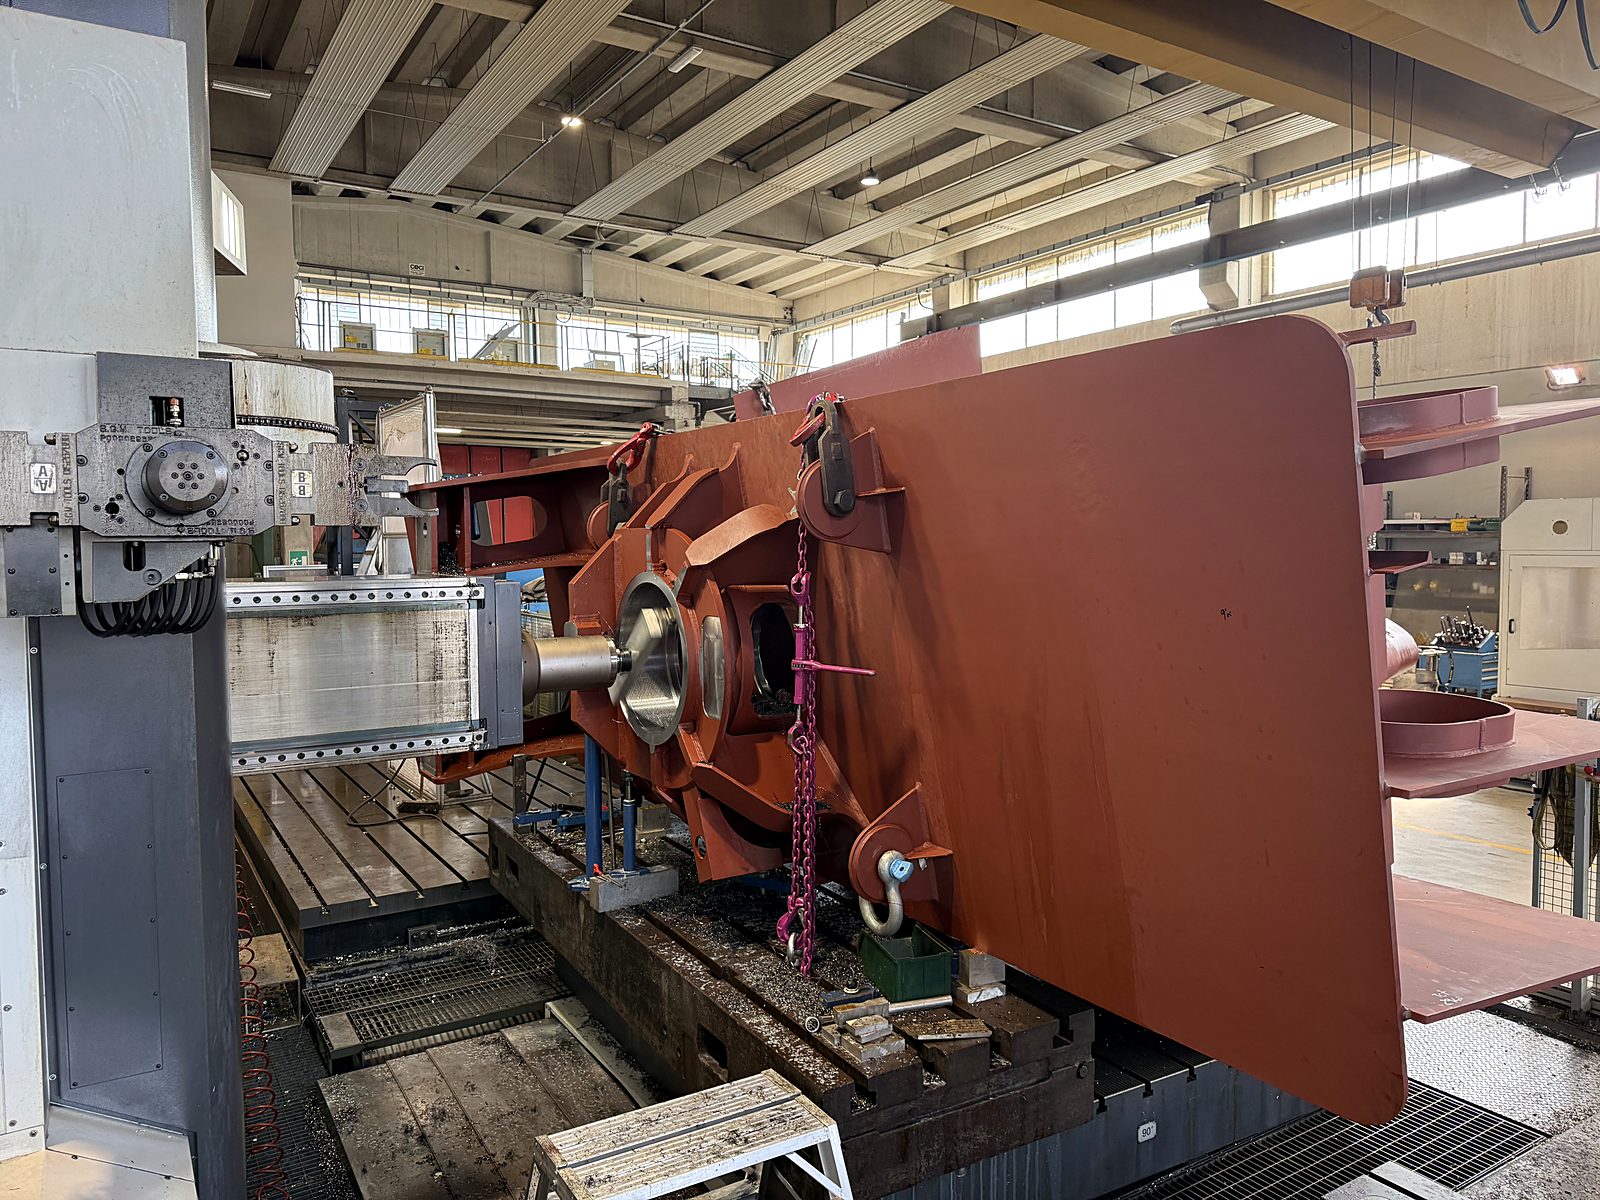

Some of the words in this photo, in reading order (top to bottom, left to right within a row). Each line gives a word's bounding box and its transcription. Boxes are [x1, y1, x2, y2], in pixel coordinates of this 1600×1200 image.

[137, 426, 172, 435] TOOLS
[38, 465, 48, 476] A
[298, 472, 306, 482] B
[38, 480, 48, 492] A
[298, 485, 306, 496] B
